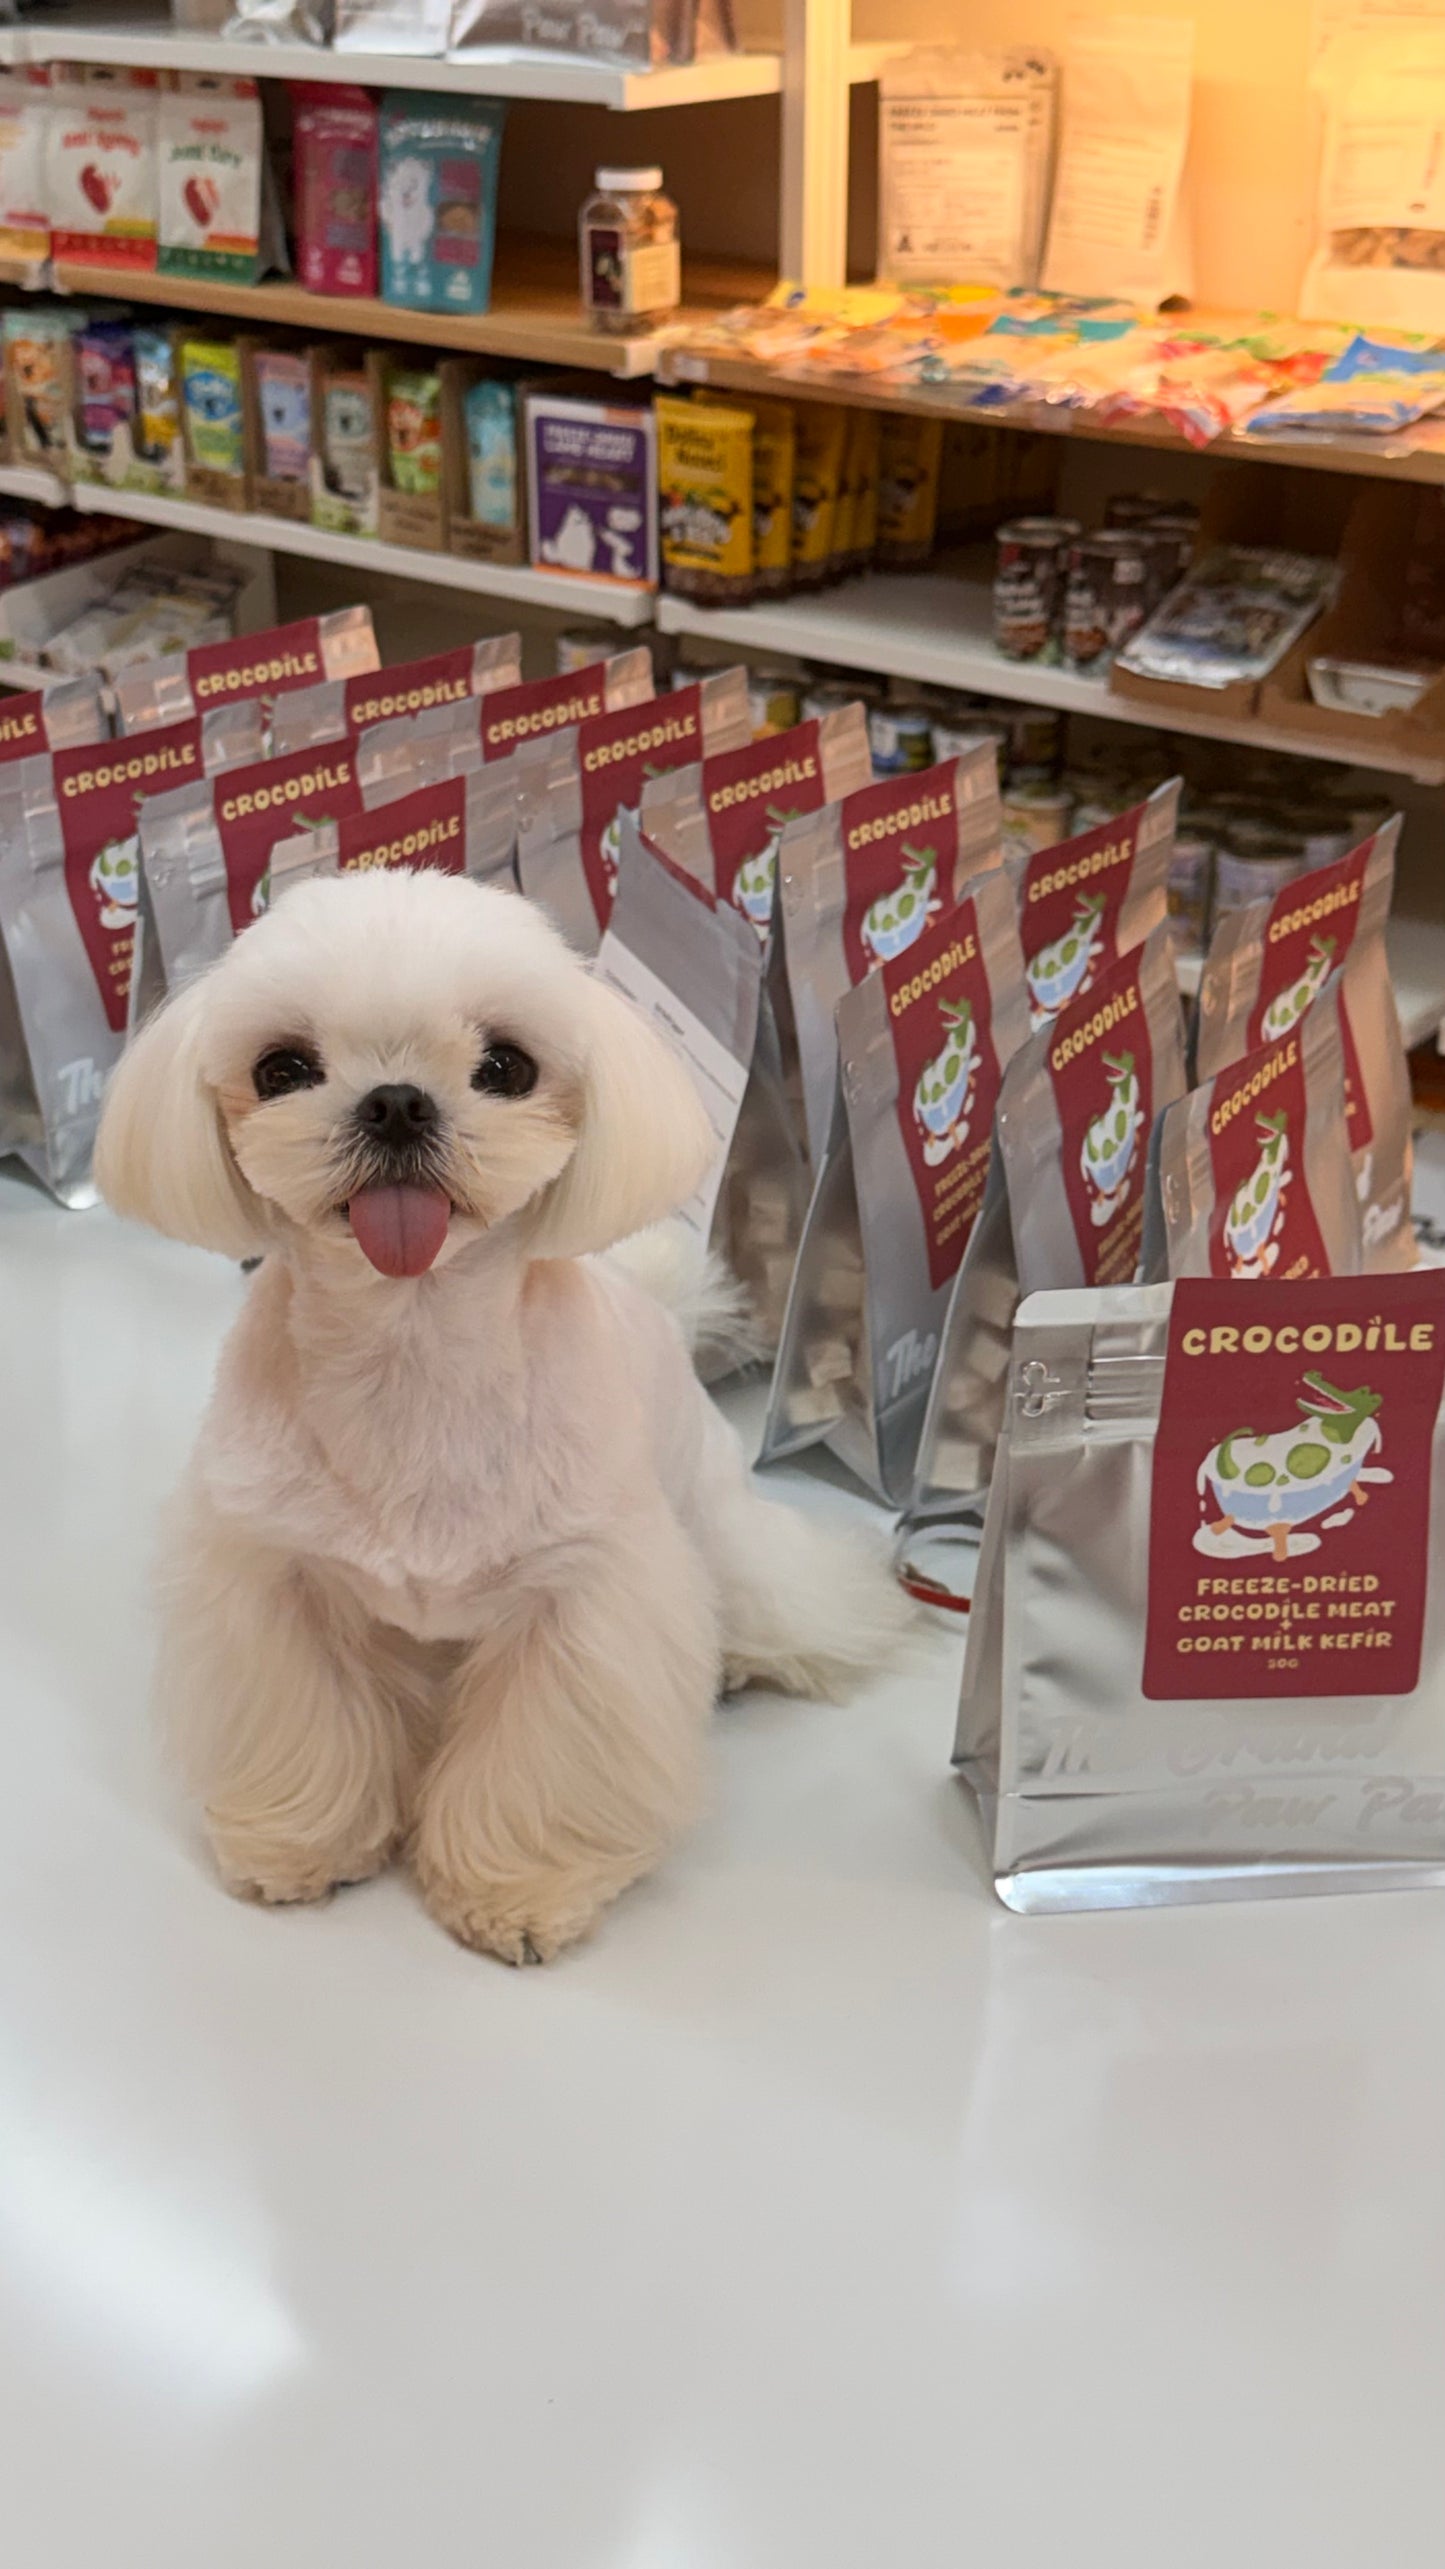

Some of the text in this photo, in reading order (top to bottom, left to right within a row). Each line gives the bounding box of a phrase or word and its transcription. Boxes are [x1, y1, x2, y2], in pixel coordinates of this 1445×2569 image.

[1327, 1600, 1395, 1618] MEAT
[1176, 1635, 1245, 1653] GOAT
[1356, 1775, 1445, 1832] Pa
